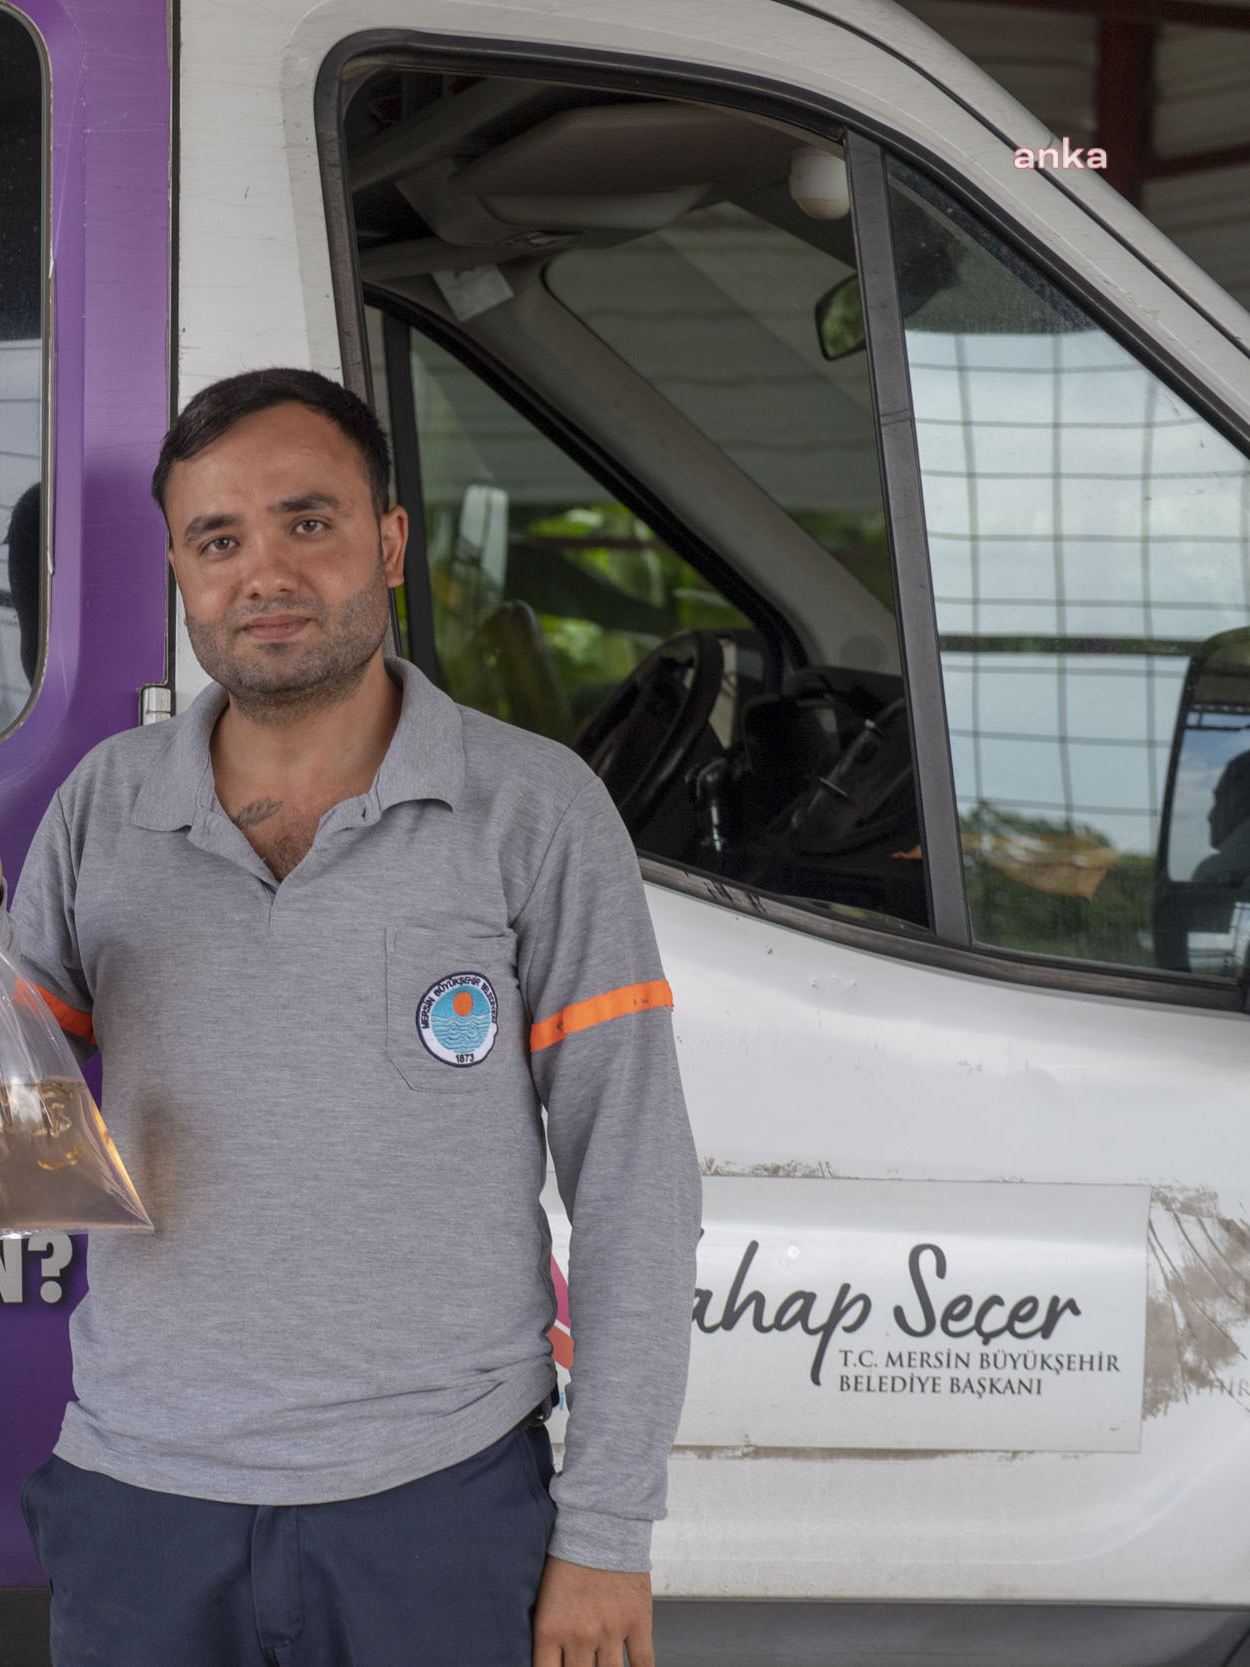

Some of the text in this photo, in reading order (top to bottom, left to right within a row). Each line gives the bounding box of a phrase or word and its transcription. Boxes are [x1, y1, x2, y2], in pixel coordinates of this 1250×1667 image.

[456, 1053, 475, 1063] 1873
[692, 1228, 1081, 1386] ahap Seçer
[839, 1349, 1121, 1376] T.C. MERSİN BÜYÜKŞEHİR
[839, 1373, 1043, 1398] BELEDİYE BAŞKANI
